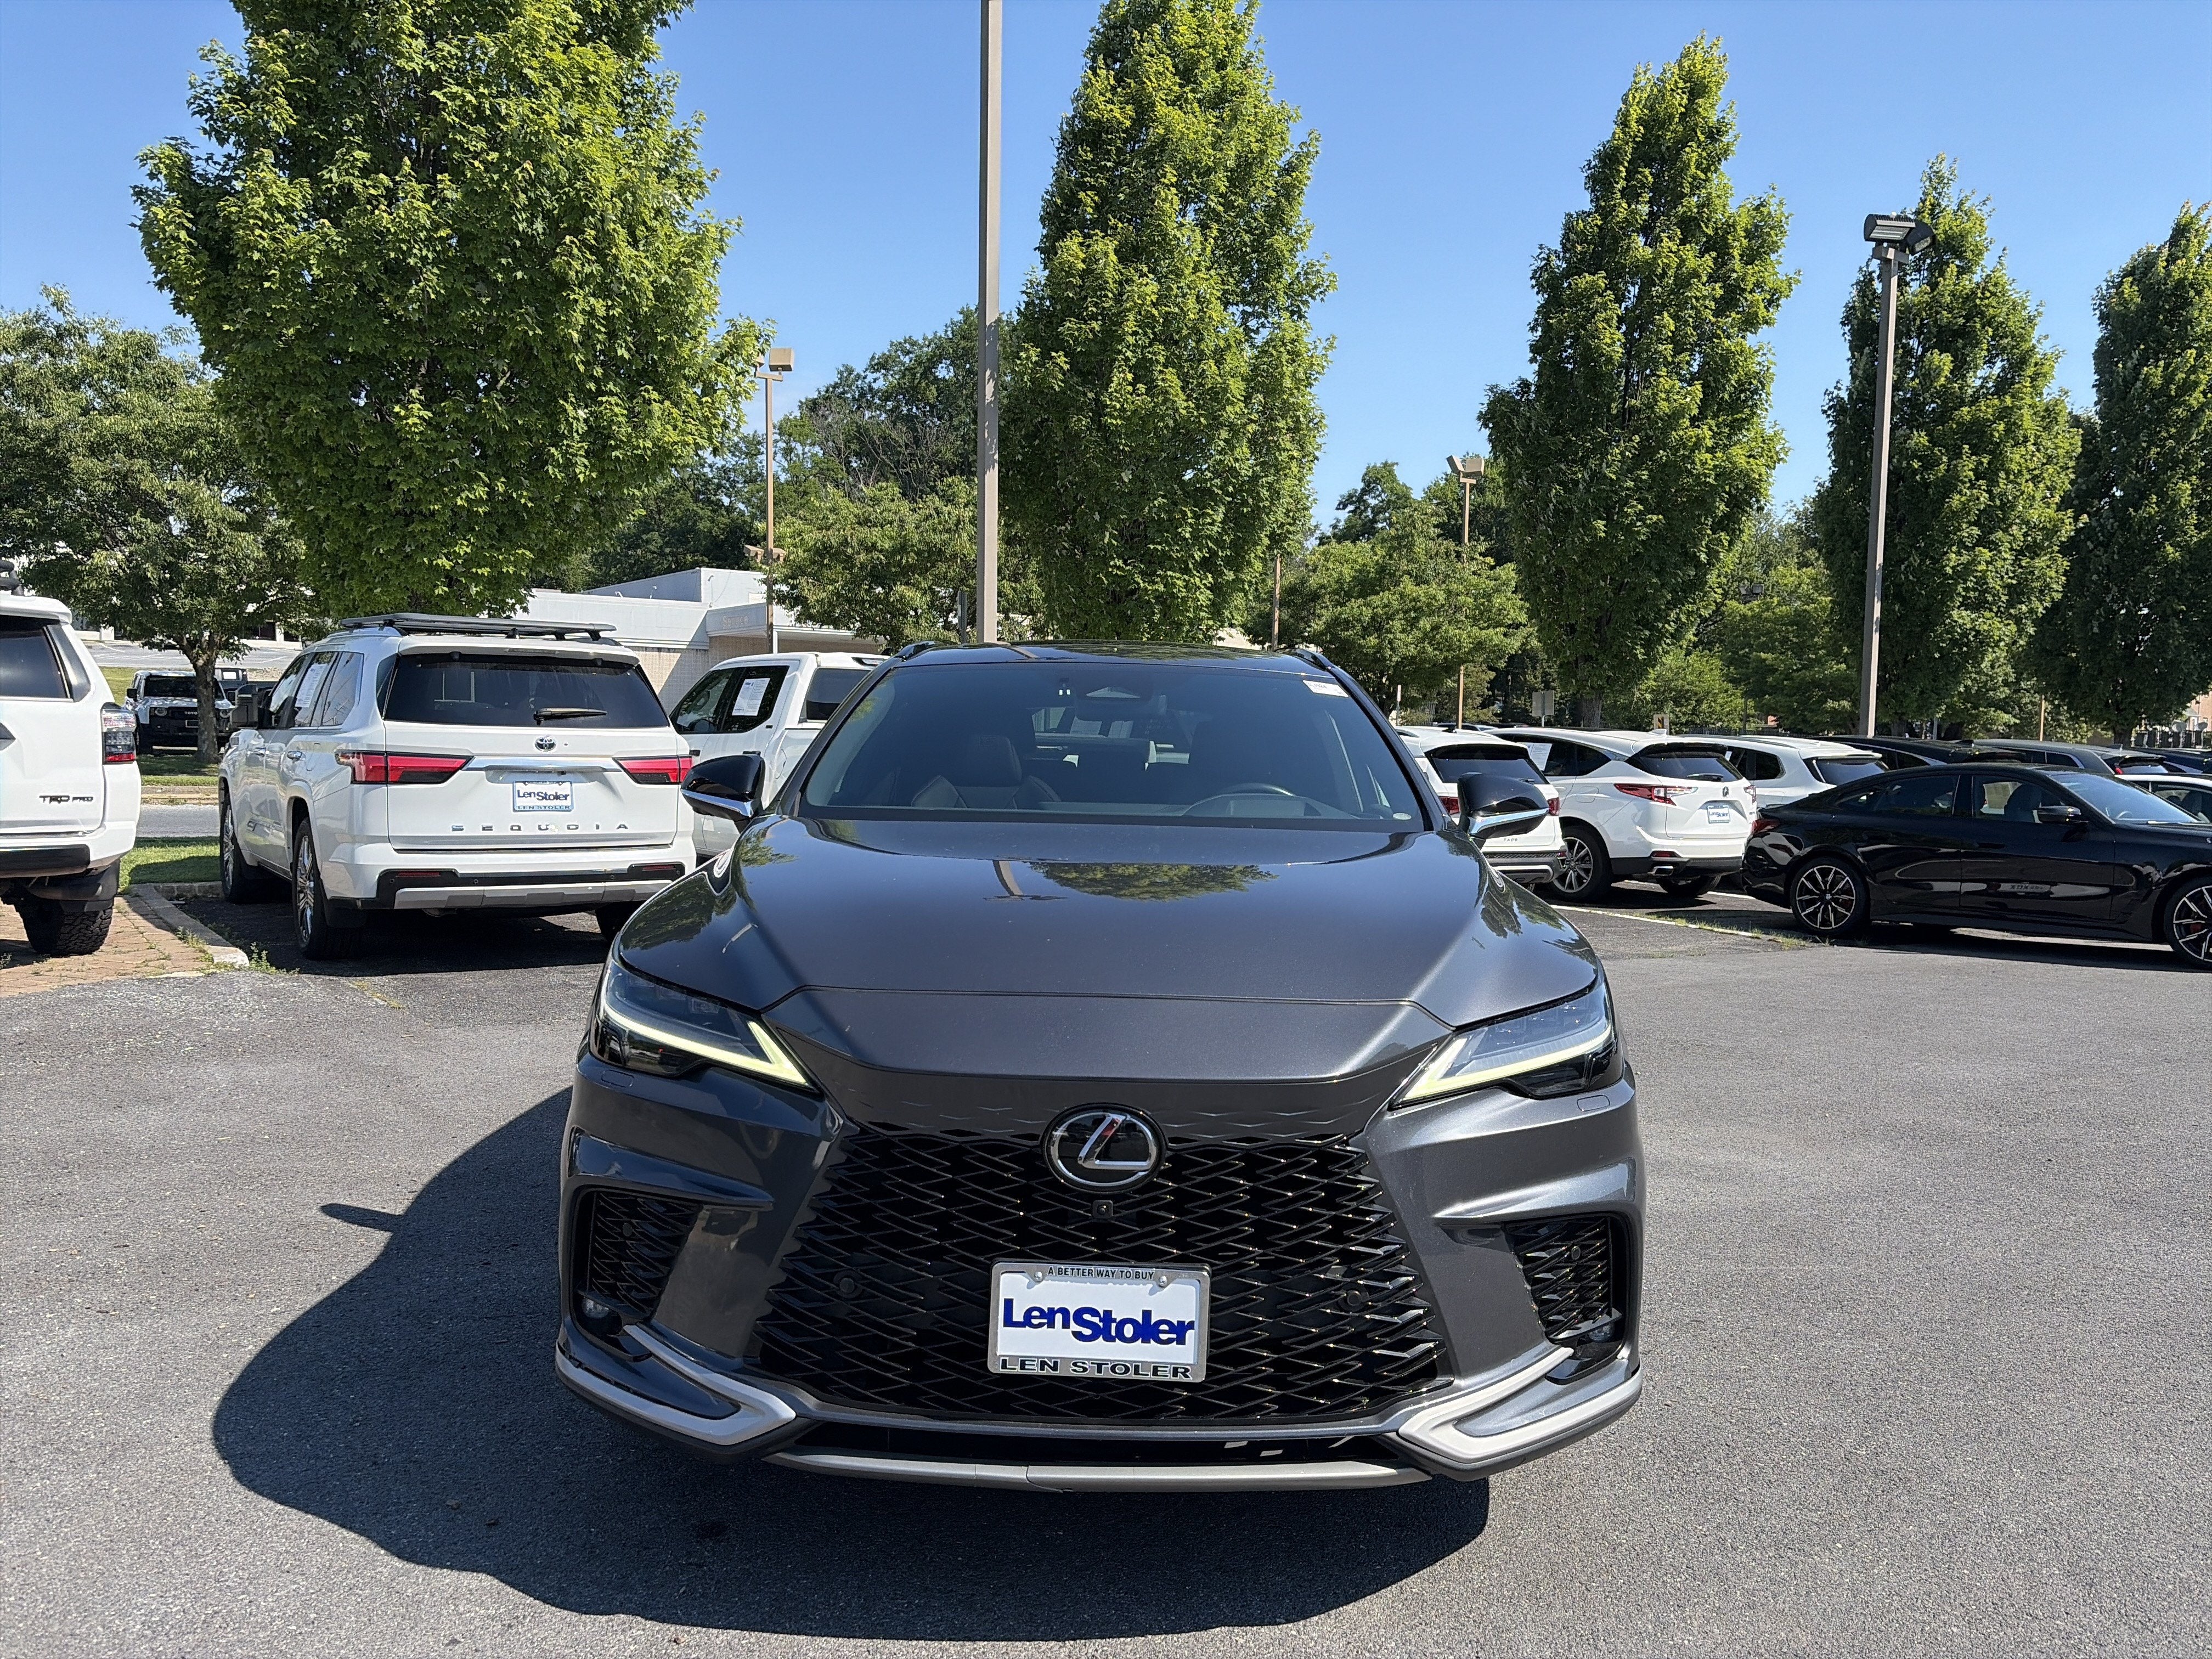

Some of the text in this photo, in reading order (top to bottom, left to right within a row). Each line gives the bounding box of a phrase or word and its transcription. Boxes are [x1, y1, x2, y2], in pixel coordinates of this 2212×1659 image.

[39, 795, 70, 804] TRD
[452, 823, 629, 832] SEQUOIA
[1048, 1267, 1154, 1280] A BETTER WAY TO BUY
[1000, 1358, 1193, 1380] LEN STOLER
